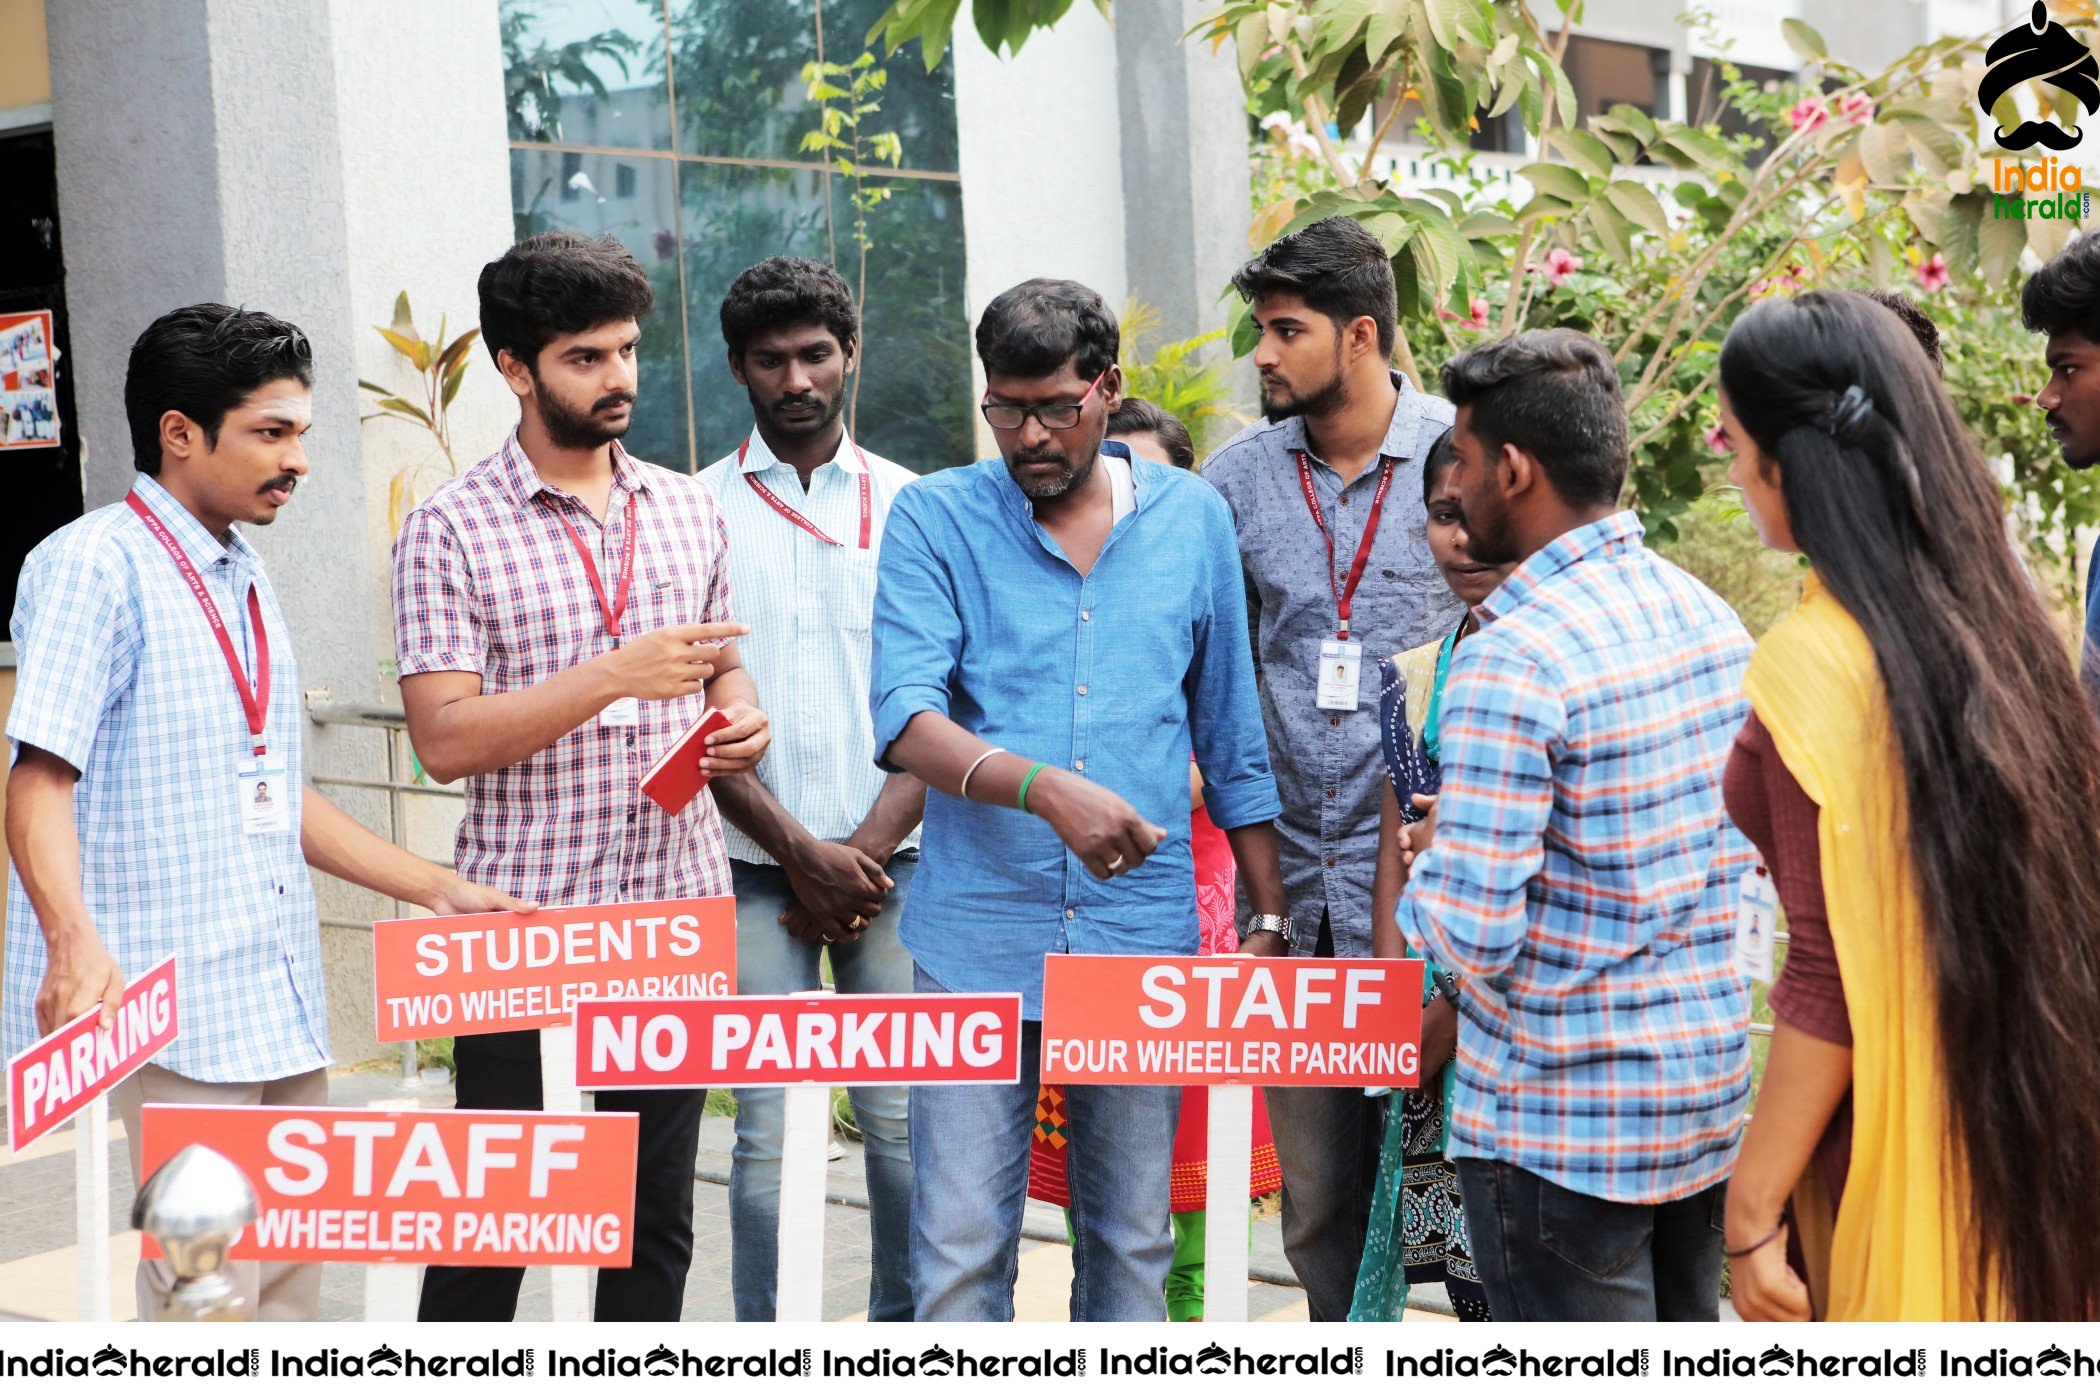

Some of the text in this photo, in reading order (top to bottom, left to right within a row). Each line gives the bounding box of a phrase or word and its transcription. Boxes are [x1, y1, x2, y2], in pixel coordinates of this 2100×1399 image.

[1300, 453, 1309, 470] ARTS
[1303, 471, 1310, 480] OF
[770, 494, 784, 508] ARTS
[1305, 480, 1318, 509] COLLEGE
[1374, 475, 1388, 505] SCIENCE
[791, 511, 814, 529] COLLEGE
[159, 531, 183, 560] COLLEGE
[180, 561, 190, 570] OF
[186, 571, 200, 590] ARTS
[202, 597, 222, 629] SCIENCE
[622, 552, 631, 580] SCIENCE
[415, 914, 701, 977] STUDENTS
[386, 993, 453, 1028] TWO
[460, 981, 597, 1023] WHEELER
[1138, 964, 1386, 1029] STAFF
[23, 978, 170, 1130] PARKING
[592, 1011, 1003, 1072] NO PARKING
[1045, 1038, 1417, 1075] FOUR WHEELER PARKING
[263, 1118, 586, 1199] STAFF
[255, 1207, 443, 1251] WHEELER
[453, 1211, 621, 1254] PARKING
